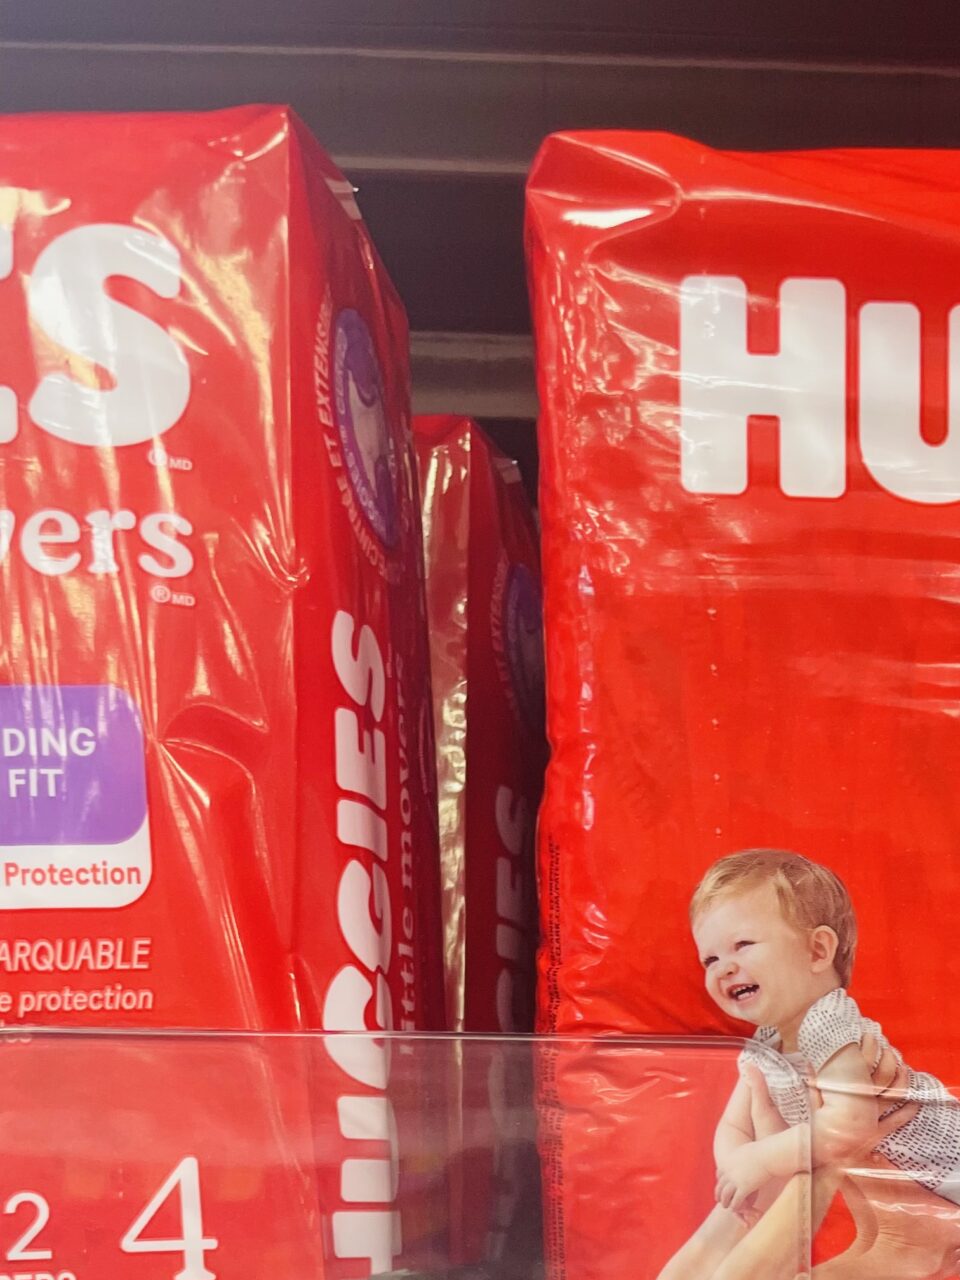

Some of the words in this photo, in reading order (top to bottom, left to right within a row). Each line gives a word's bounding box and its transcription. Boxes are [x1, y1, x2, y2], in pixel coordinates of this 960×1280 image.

[0, 223, 191, 447] S
[2, 727, 97, 757] DING
[8, 768, 65, 798] FIT
[4, 861, 142, 886] Protection
[18, 985, 154, 1018] protection
[4, 1190, 53, 1261] 2
